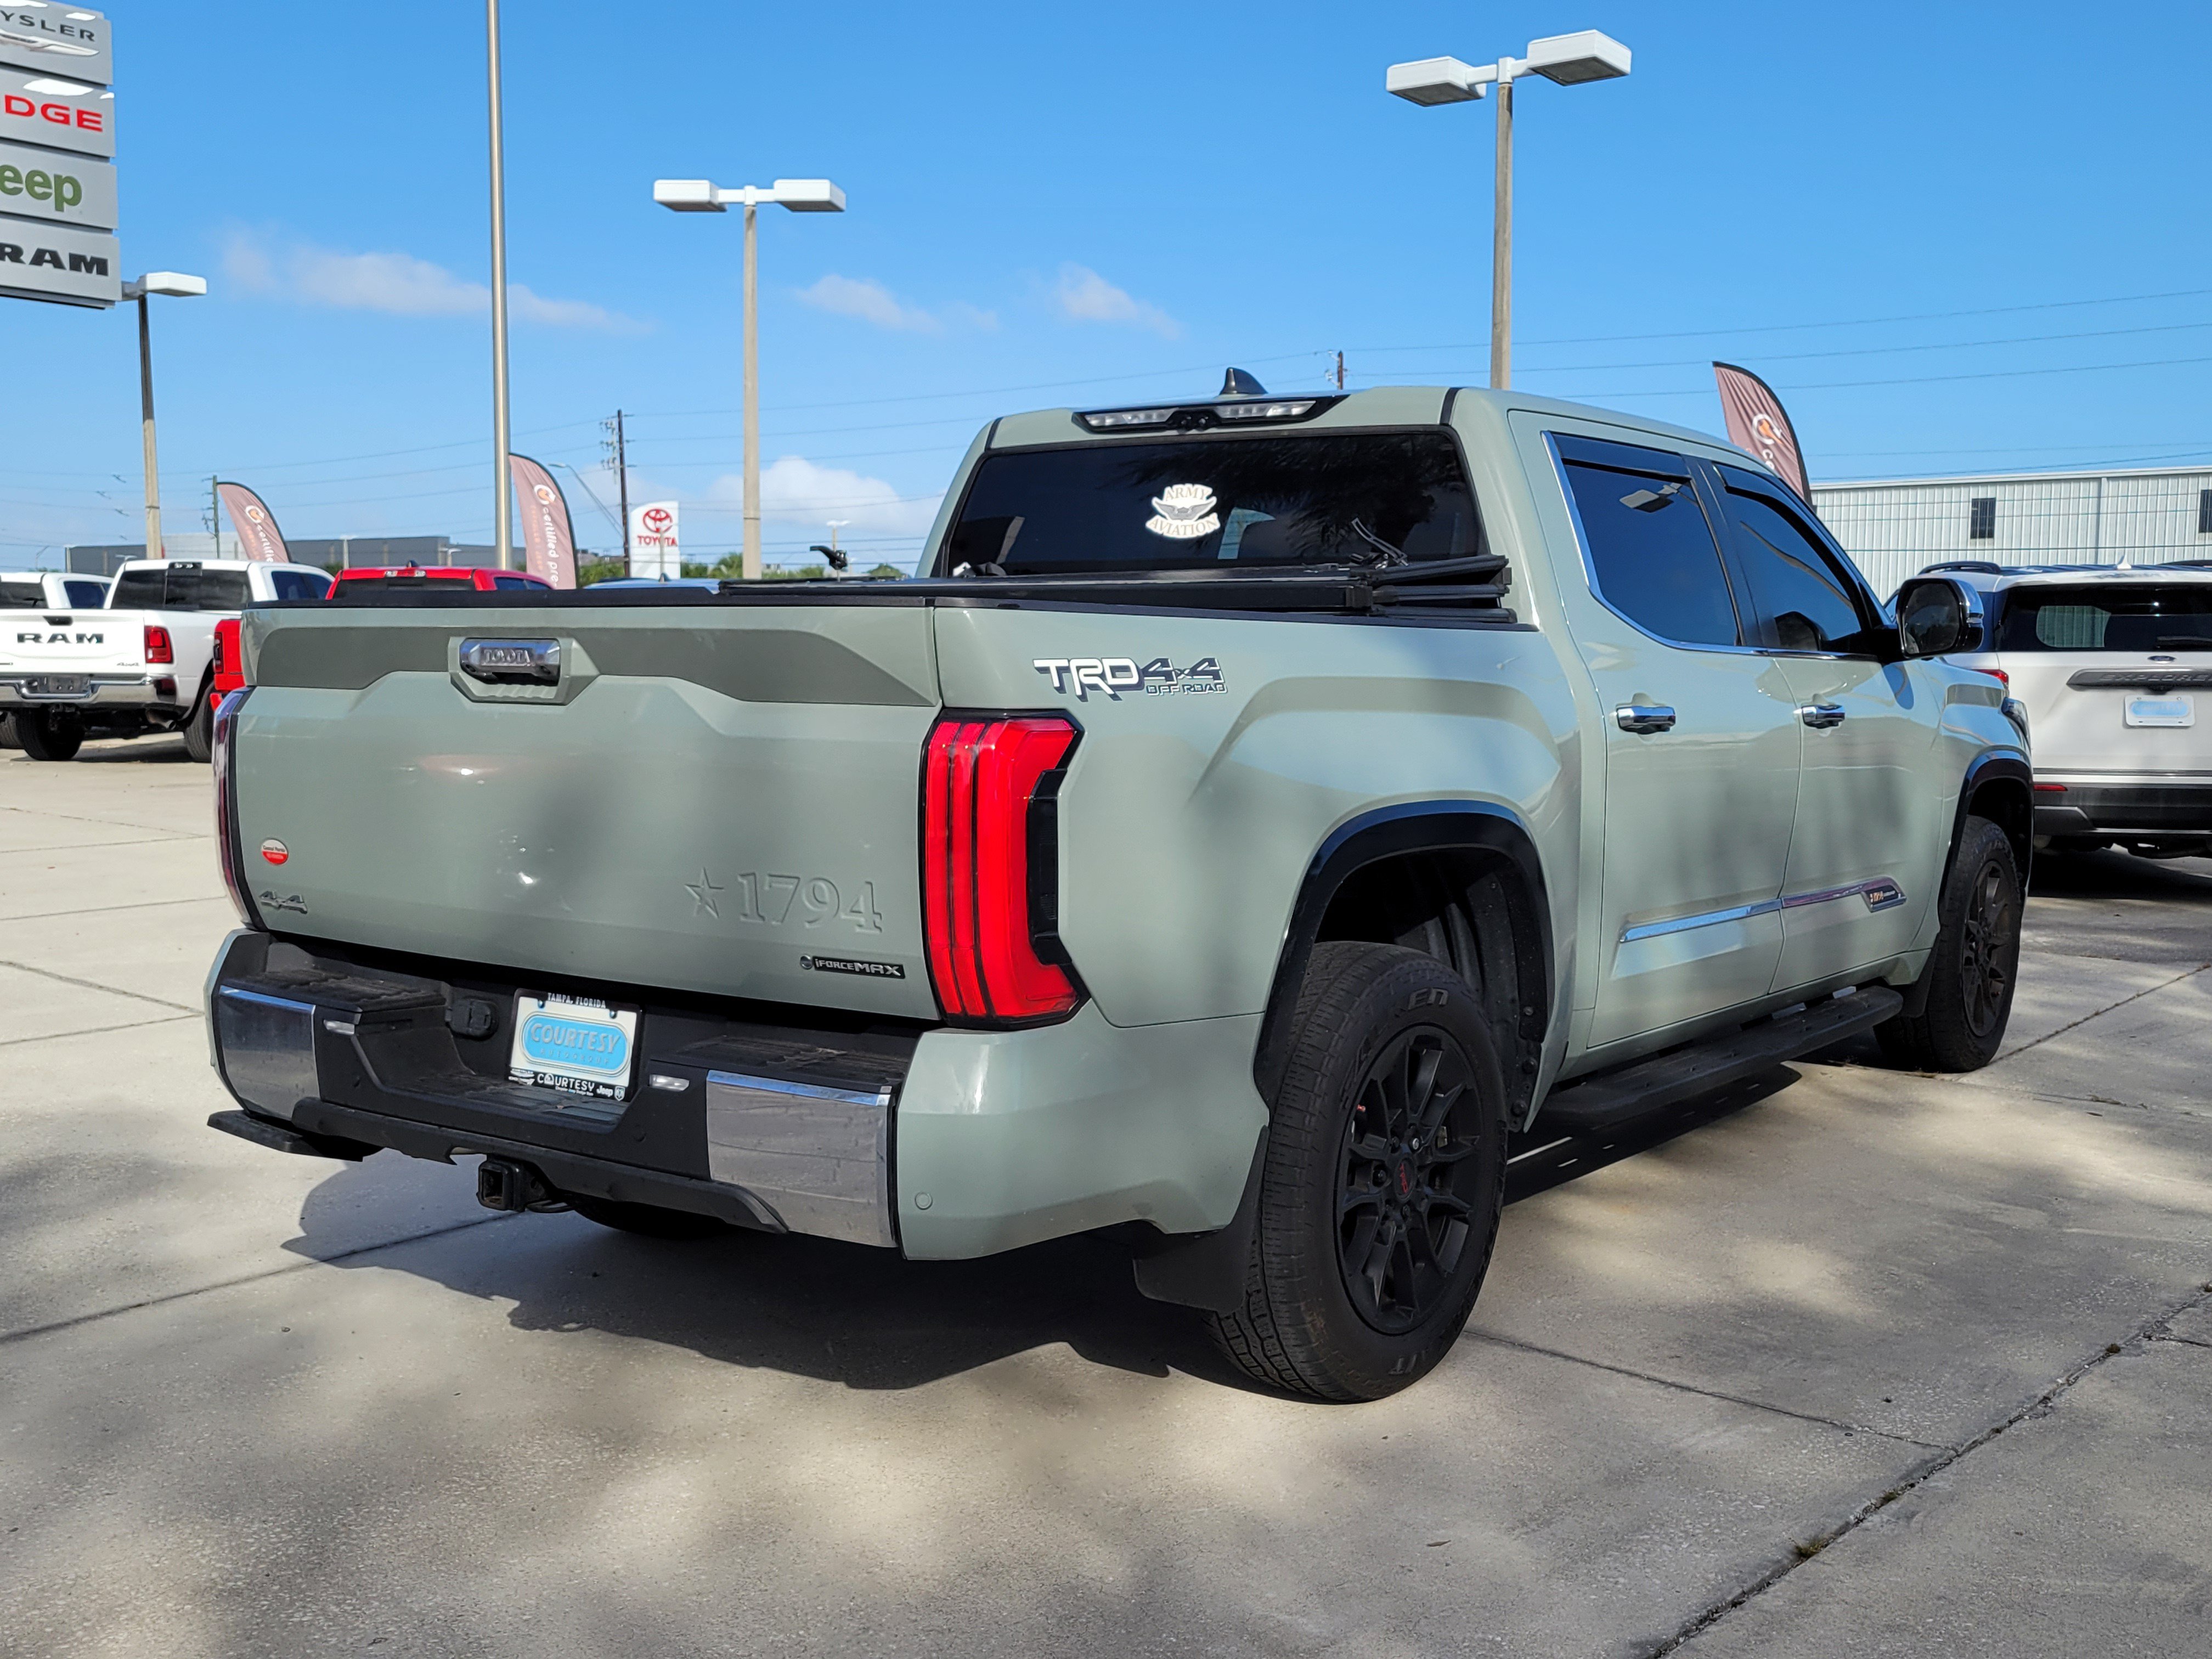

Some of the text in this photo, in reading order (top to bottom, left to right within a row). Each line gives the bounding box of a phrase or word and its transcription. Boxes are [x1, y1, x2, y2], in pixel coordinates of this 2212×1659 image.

[4, 94, 103, 132] DGE
[0, 165, 82, 212] eep
[0, 242, 109, 276] RAM
[1165, 486, 1210, 501] ARMY
[1149, 516, 1218, 536] AVIATION
[17, 633, 104, 644] RAM
[483, 648, 531, 663] TOYOTA
[1033, 658, 1144, 702] TRD
[1146, 684, 1228, 696] OFF ROAD
[737, 871, 883, 934] 1794
[548, 992, 606, 1009] TAMPA, FLORIDA
[531, 1023, 620, 1053] COURTESY
[596, 1085, 613, 1097] Jeep
